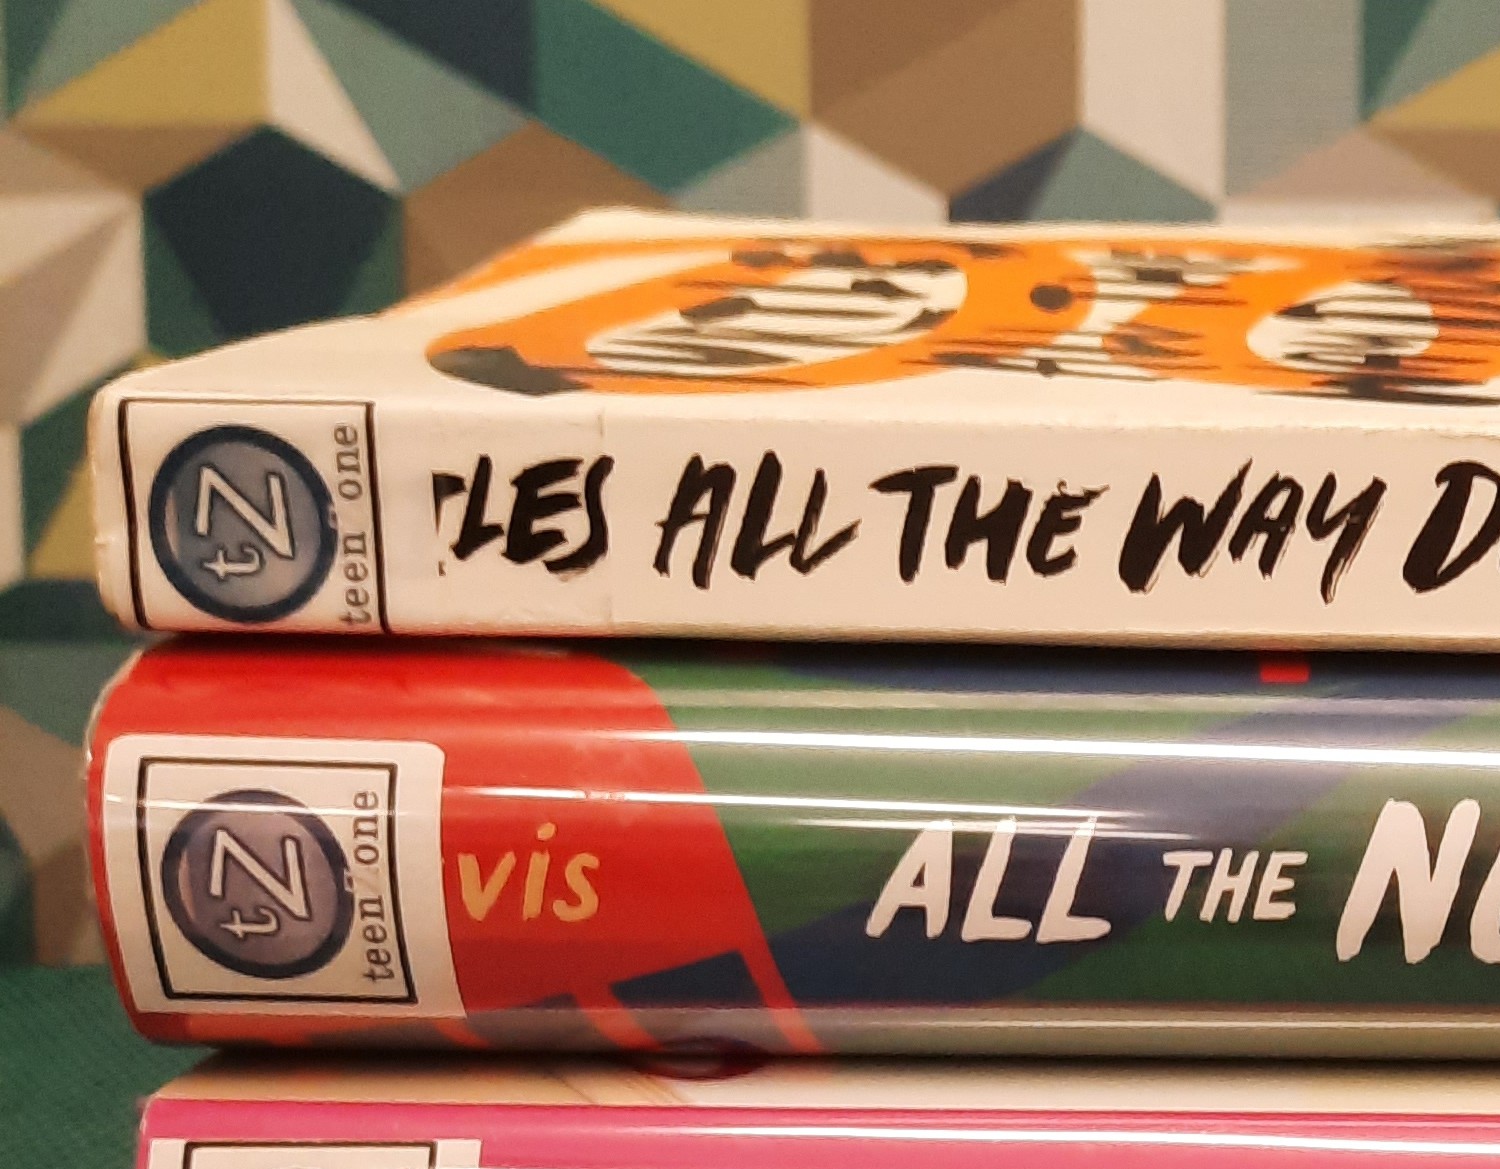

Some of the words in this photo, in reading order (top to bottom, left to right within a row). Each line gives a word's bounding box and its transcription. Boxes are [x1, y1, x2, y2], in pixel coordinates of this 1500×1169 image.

[654, 449, 861, 589] ALL
[870, 462, 1110, 586] THE
[1118, 458, 1387, 605] WAY
[458, 821, 600, 923] vis
[866, 815, 1112, 944] ALL
[1162, 847, 1308, 923] THE
